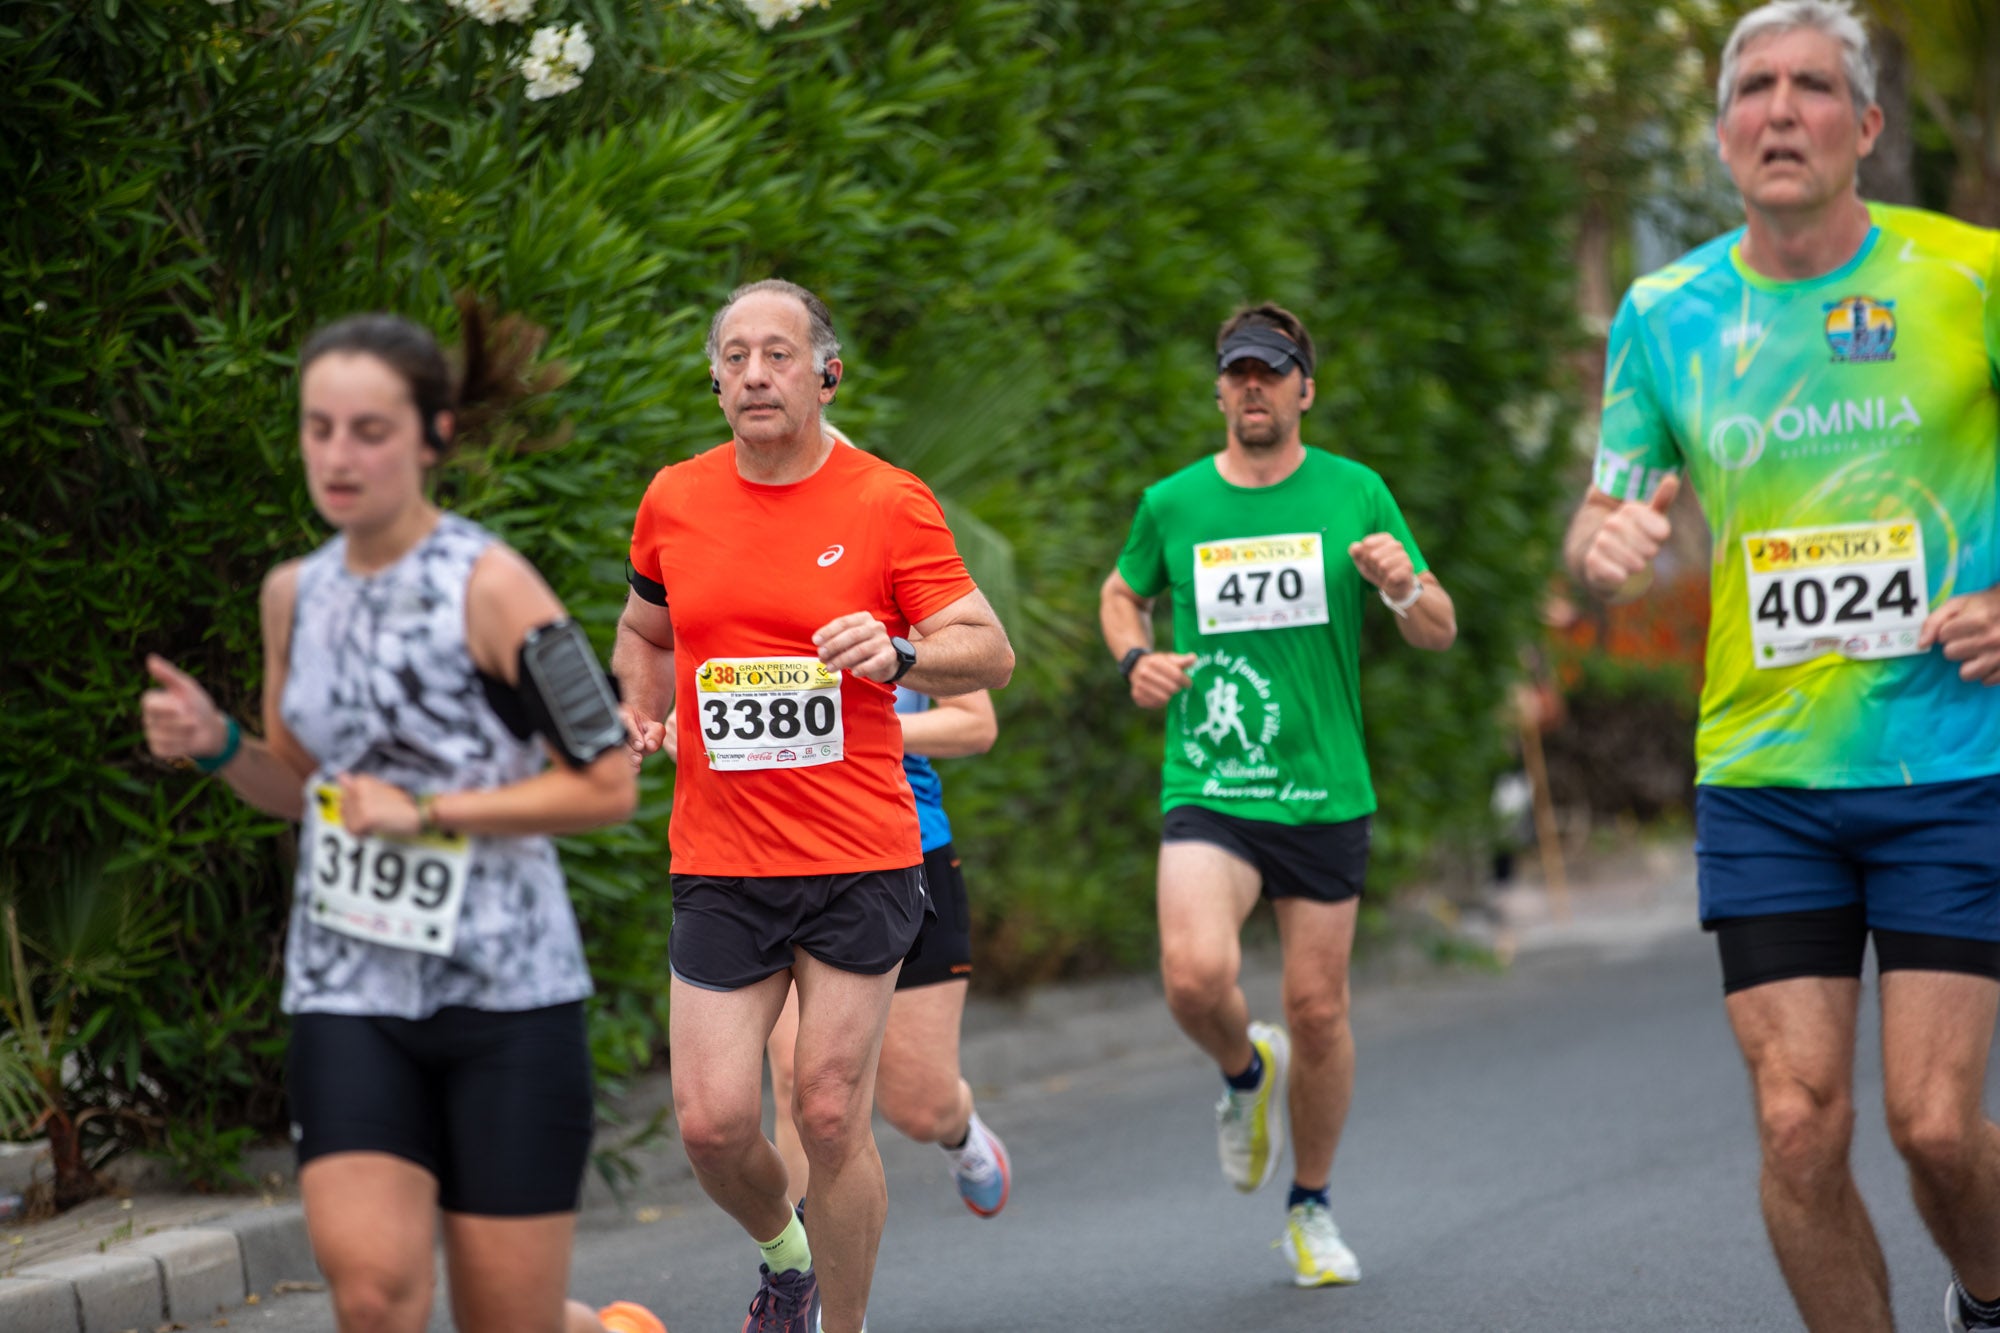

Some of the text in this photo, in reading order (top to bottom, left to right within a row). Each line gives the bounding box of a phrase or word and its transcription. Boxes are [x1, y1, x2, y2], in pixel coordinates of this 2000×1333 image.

[1773, 397, 1921, 440] OMNIA
[1217, 568, 1304, 606] 470
[1757, 567, 1919, 629] 4024
[713, 666, 810, 686] 38 FONDO
[739, 664, 765, 672] GRAN
[767, 663, 802, 671] PREMIO
[1214, 649, 1232, 667] de
[1228, 656, 1271, 699] fondo
[704, 695, 836, 741] 3380
[319, 834, 452, 911] 3199
